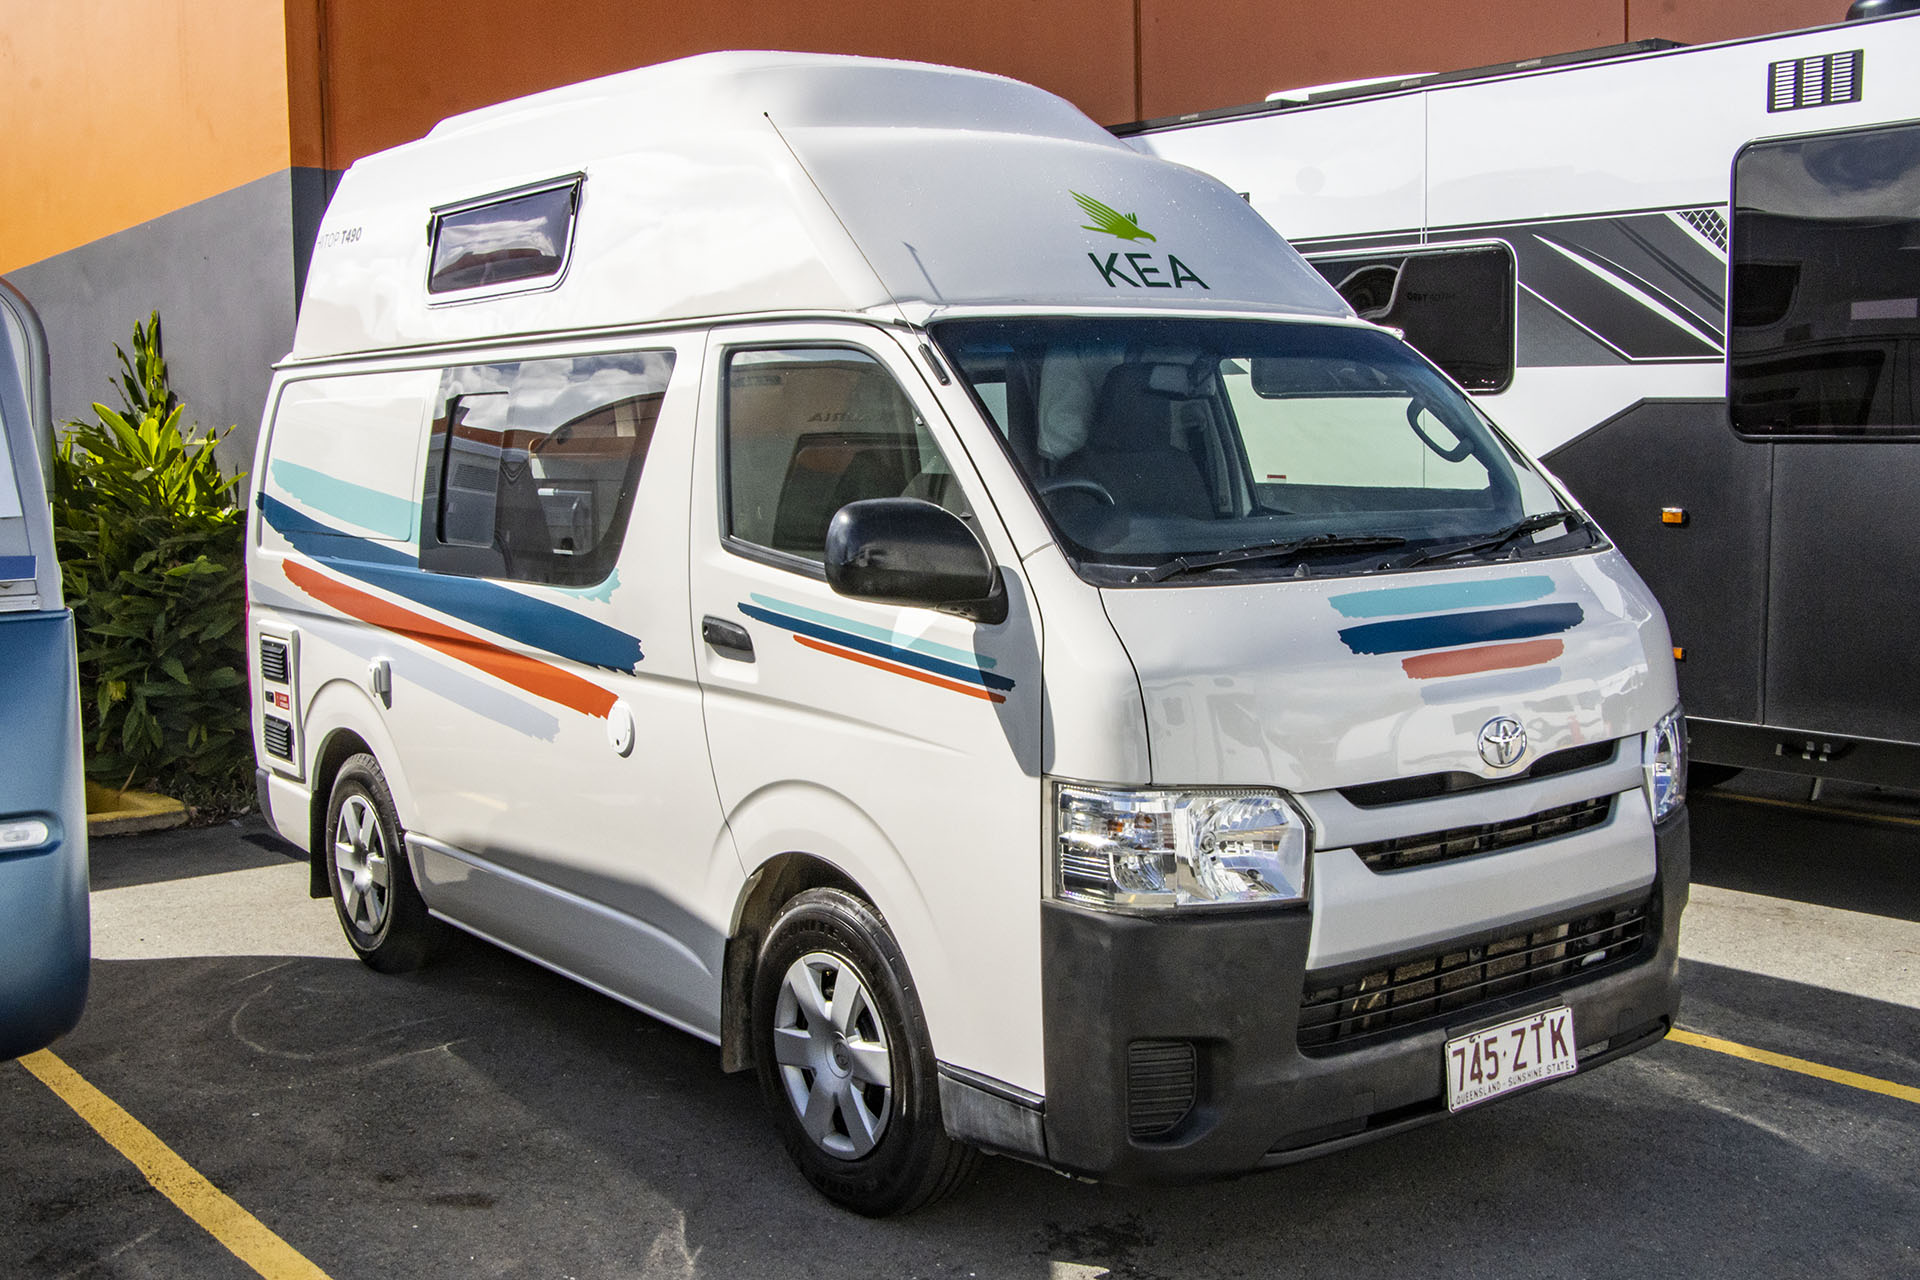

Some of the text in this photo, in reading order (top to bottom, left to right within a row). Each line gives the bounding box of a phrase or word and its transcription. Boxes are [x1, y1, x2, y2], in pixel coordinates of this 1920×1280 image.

[341, 227, 362, 244] T490
[1087, 252, 1211, 289] KEA
[1456, 1081, 1501, 1106] QUEENSLAND
[1508, 1067, 1542, 1087] SUNSHINE
[1546, 1060, 1570, 1074] STATE
